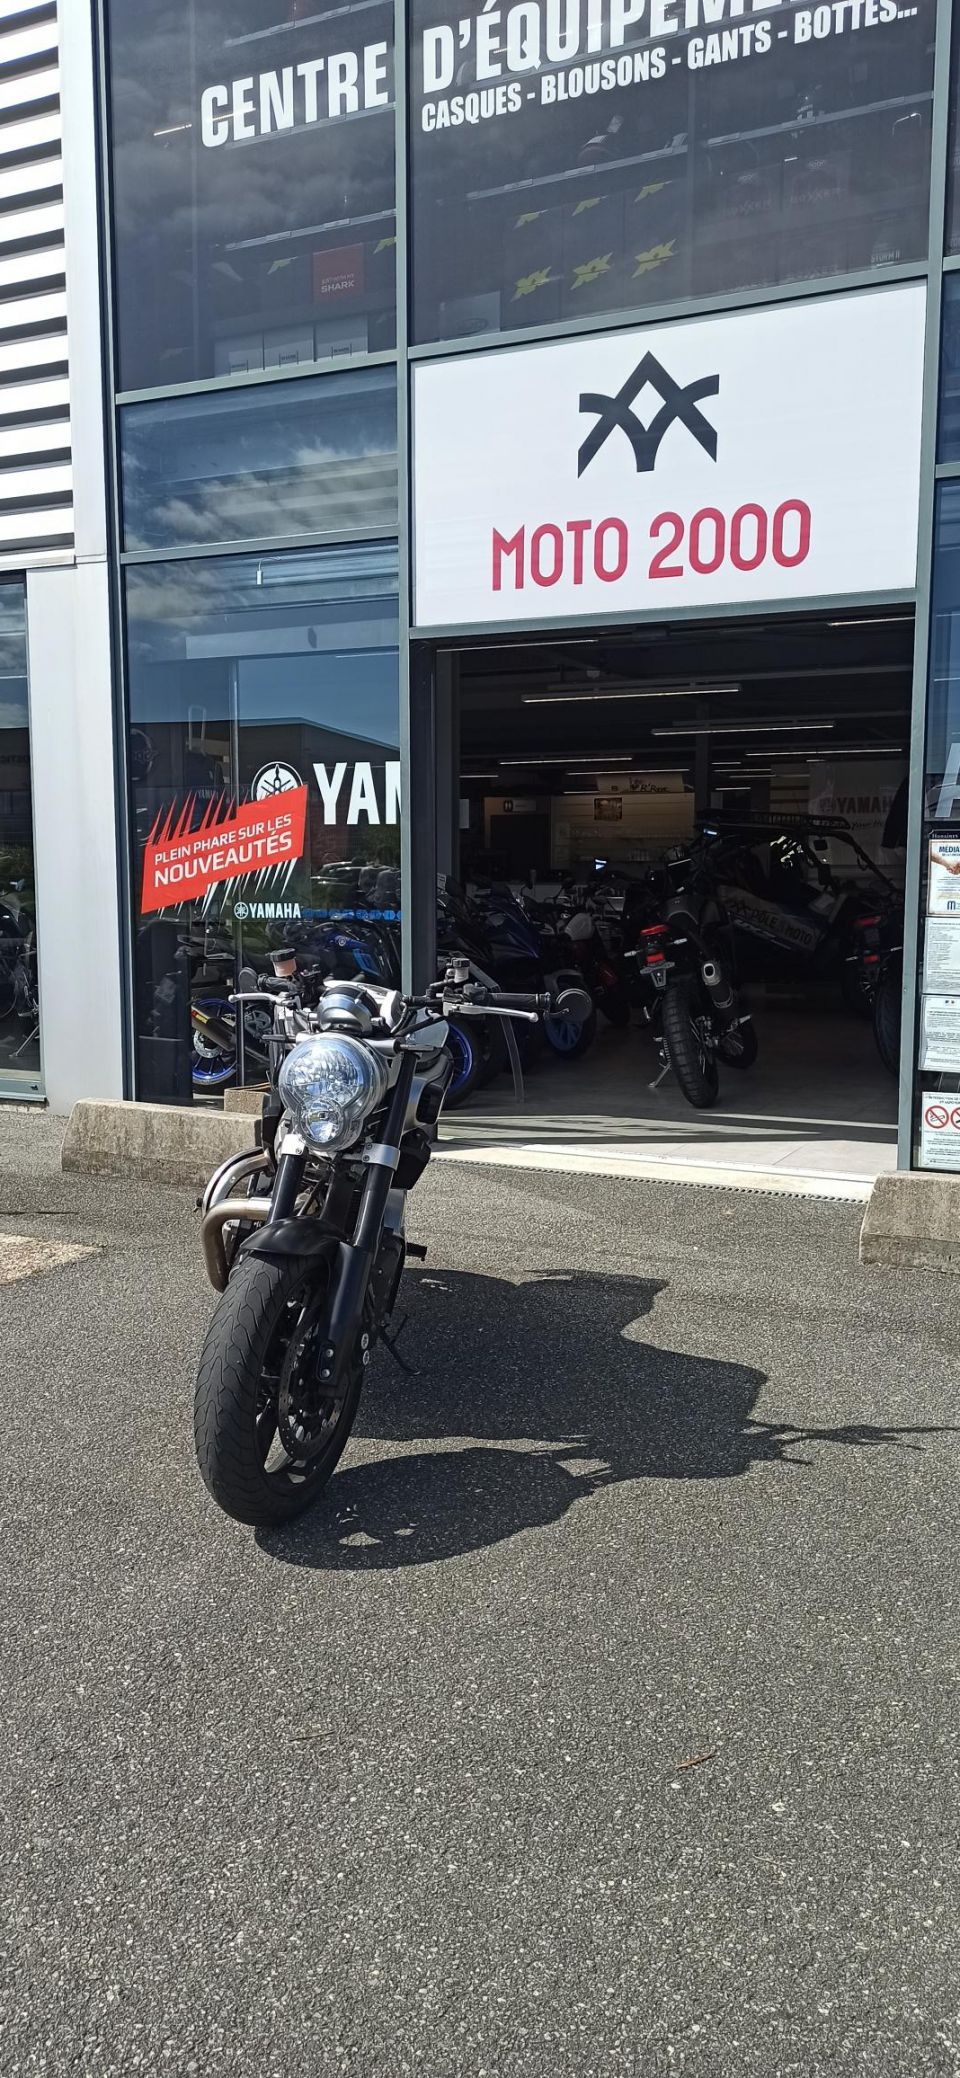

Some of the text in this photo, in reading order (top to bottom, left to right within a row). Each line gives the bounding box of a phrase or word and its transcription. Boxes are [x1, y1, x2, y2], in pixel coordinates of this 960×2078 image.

[201, 0, 806, 148] CENTRE D'ÉQUIPE
[421, 82, 522, 132] CASQUES
[526, 91, 536, 99] -
[541, 47, 666, 105] BLOUSONS
[671, 57, 681, 66] -
[687, 20, 772, 70] GANTS
[777, 30, 788, 39] -
[321, 280, 355, 293] SHARK
[492, 498, 811, 591] MOTO 2000
[836, 797, 894, 813] YAMAH
[154, 813, 292, 865] PLEIN PHARE SUR LES
[154, 828, 293, 888] NOUVEAUTÉS
[939, 844, 960, 853] MÉDIA
[249, 902, 301, 919] YAMAHA
